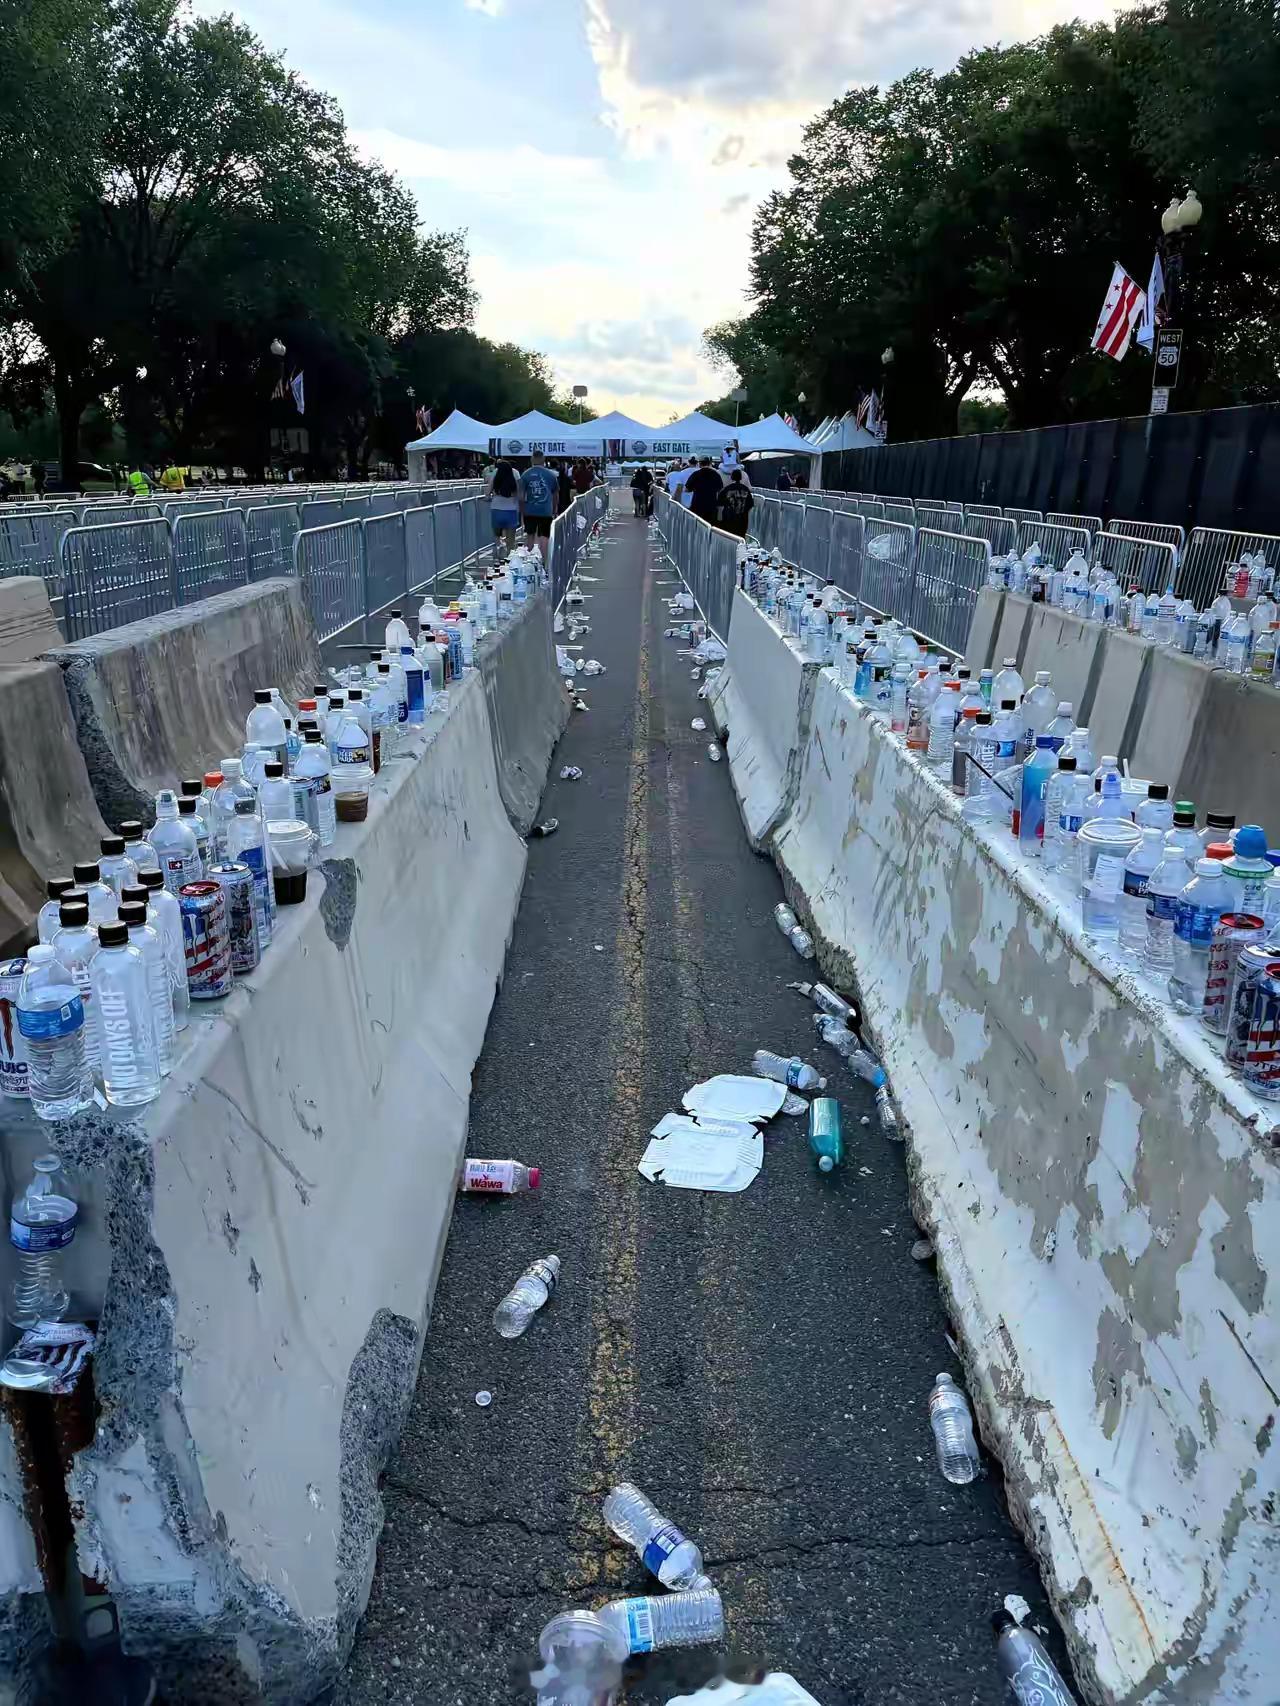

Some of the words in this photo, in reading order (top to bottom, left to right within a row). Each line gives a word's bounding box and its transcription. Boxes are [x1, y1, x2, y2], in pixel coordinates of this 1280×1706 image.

[1160, 334, 1180, 343] WEST
[1160, 353, 1174, 364] 50
[528, 442, 546, 453] EAST
[653, 442, 670, 453] EAST
[672, 442, 690, 453] GATE
[98, 990, 128, 1017] OFF
[103, 1020, 136, 1063] DAYS
[470, 1178, 503, 1189] Wawa
